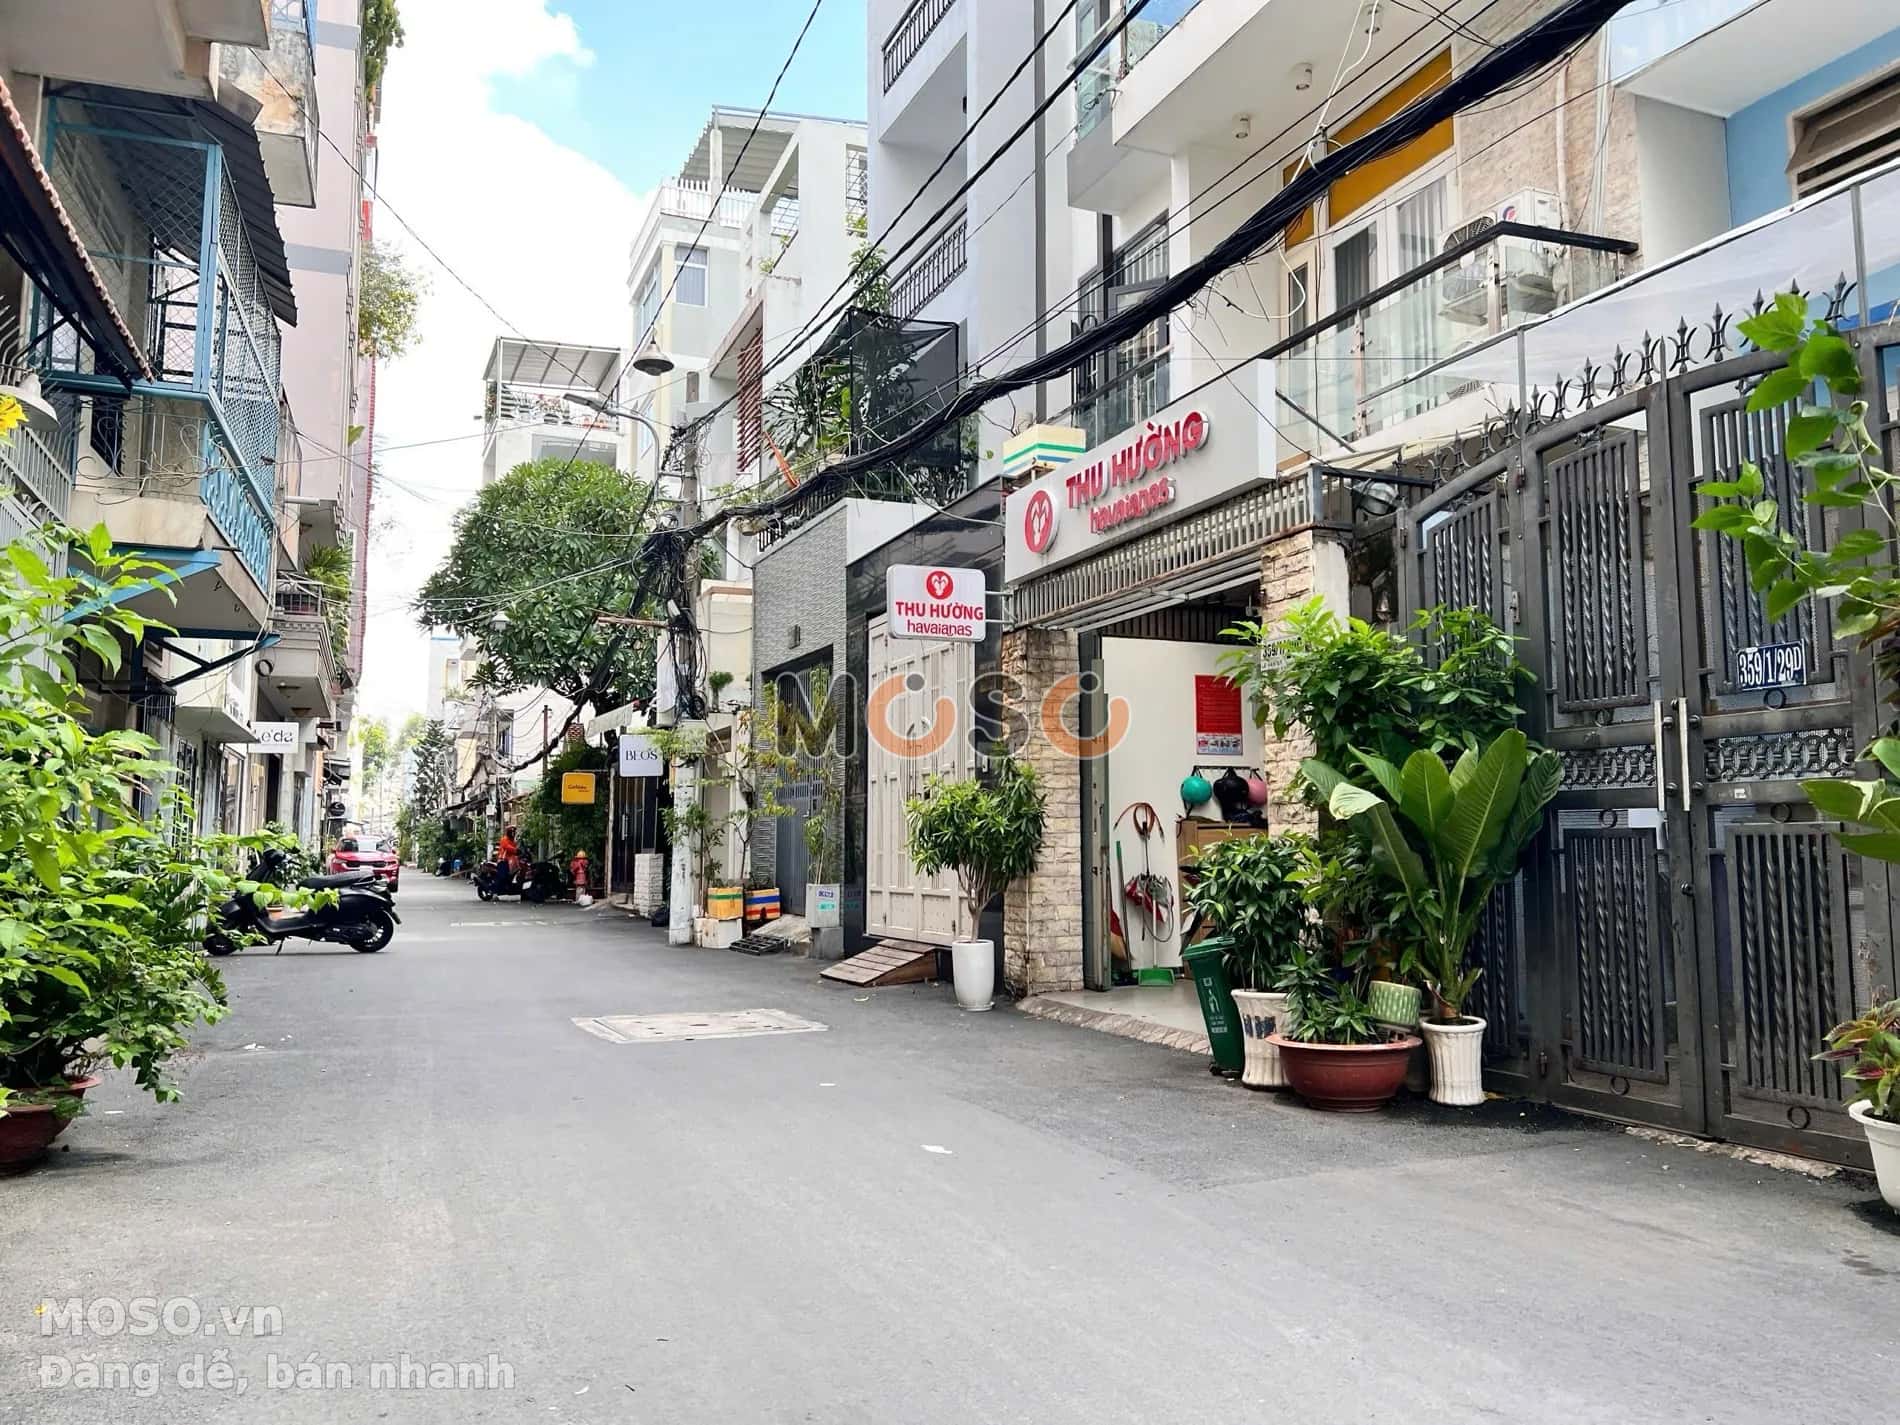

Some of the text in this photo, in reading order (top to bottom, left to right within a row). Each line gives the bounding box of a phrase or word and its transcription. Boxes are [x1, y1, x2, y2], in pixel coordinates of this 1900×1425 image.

[1066, 410, 1205, 509] THU HƯỜNG
[1090, 476, 1174, 534] havaianas
[895, 601, 984, 620] THU HƯỜNG
[907, 619, 973, 636] havaianas
[1739, 646, 1802, 687] 359/1/29D
